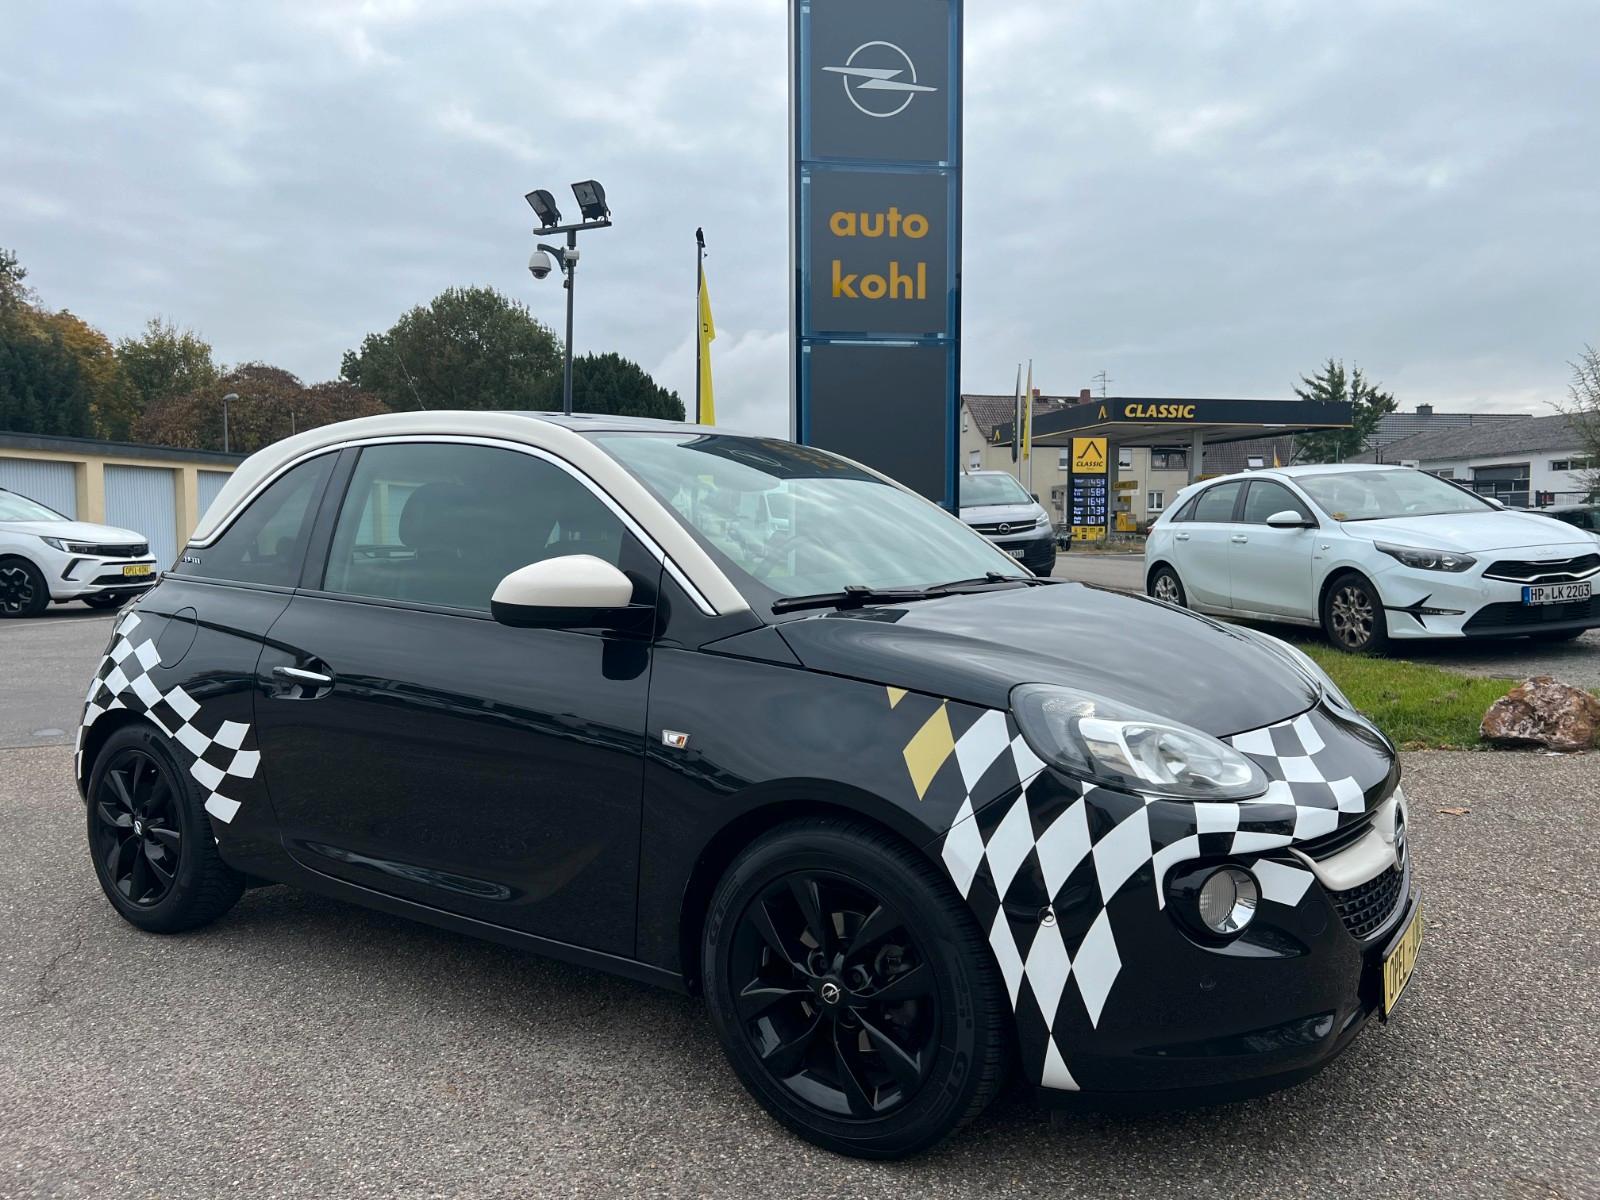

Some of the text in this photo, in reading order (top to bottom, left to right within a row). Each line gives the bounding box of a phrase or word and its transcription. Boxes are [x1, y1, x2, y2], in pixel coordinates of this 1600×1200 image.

[830, 207, 929, 239] auto
[832, 259, 927, 299] kohl
[1124, 403, 1196, 419] CLASSIC
[1531, 584, 1590, 601] HP LK 2203
